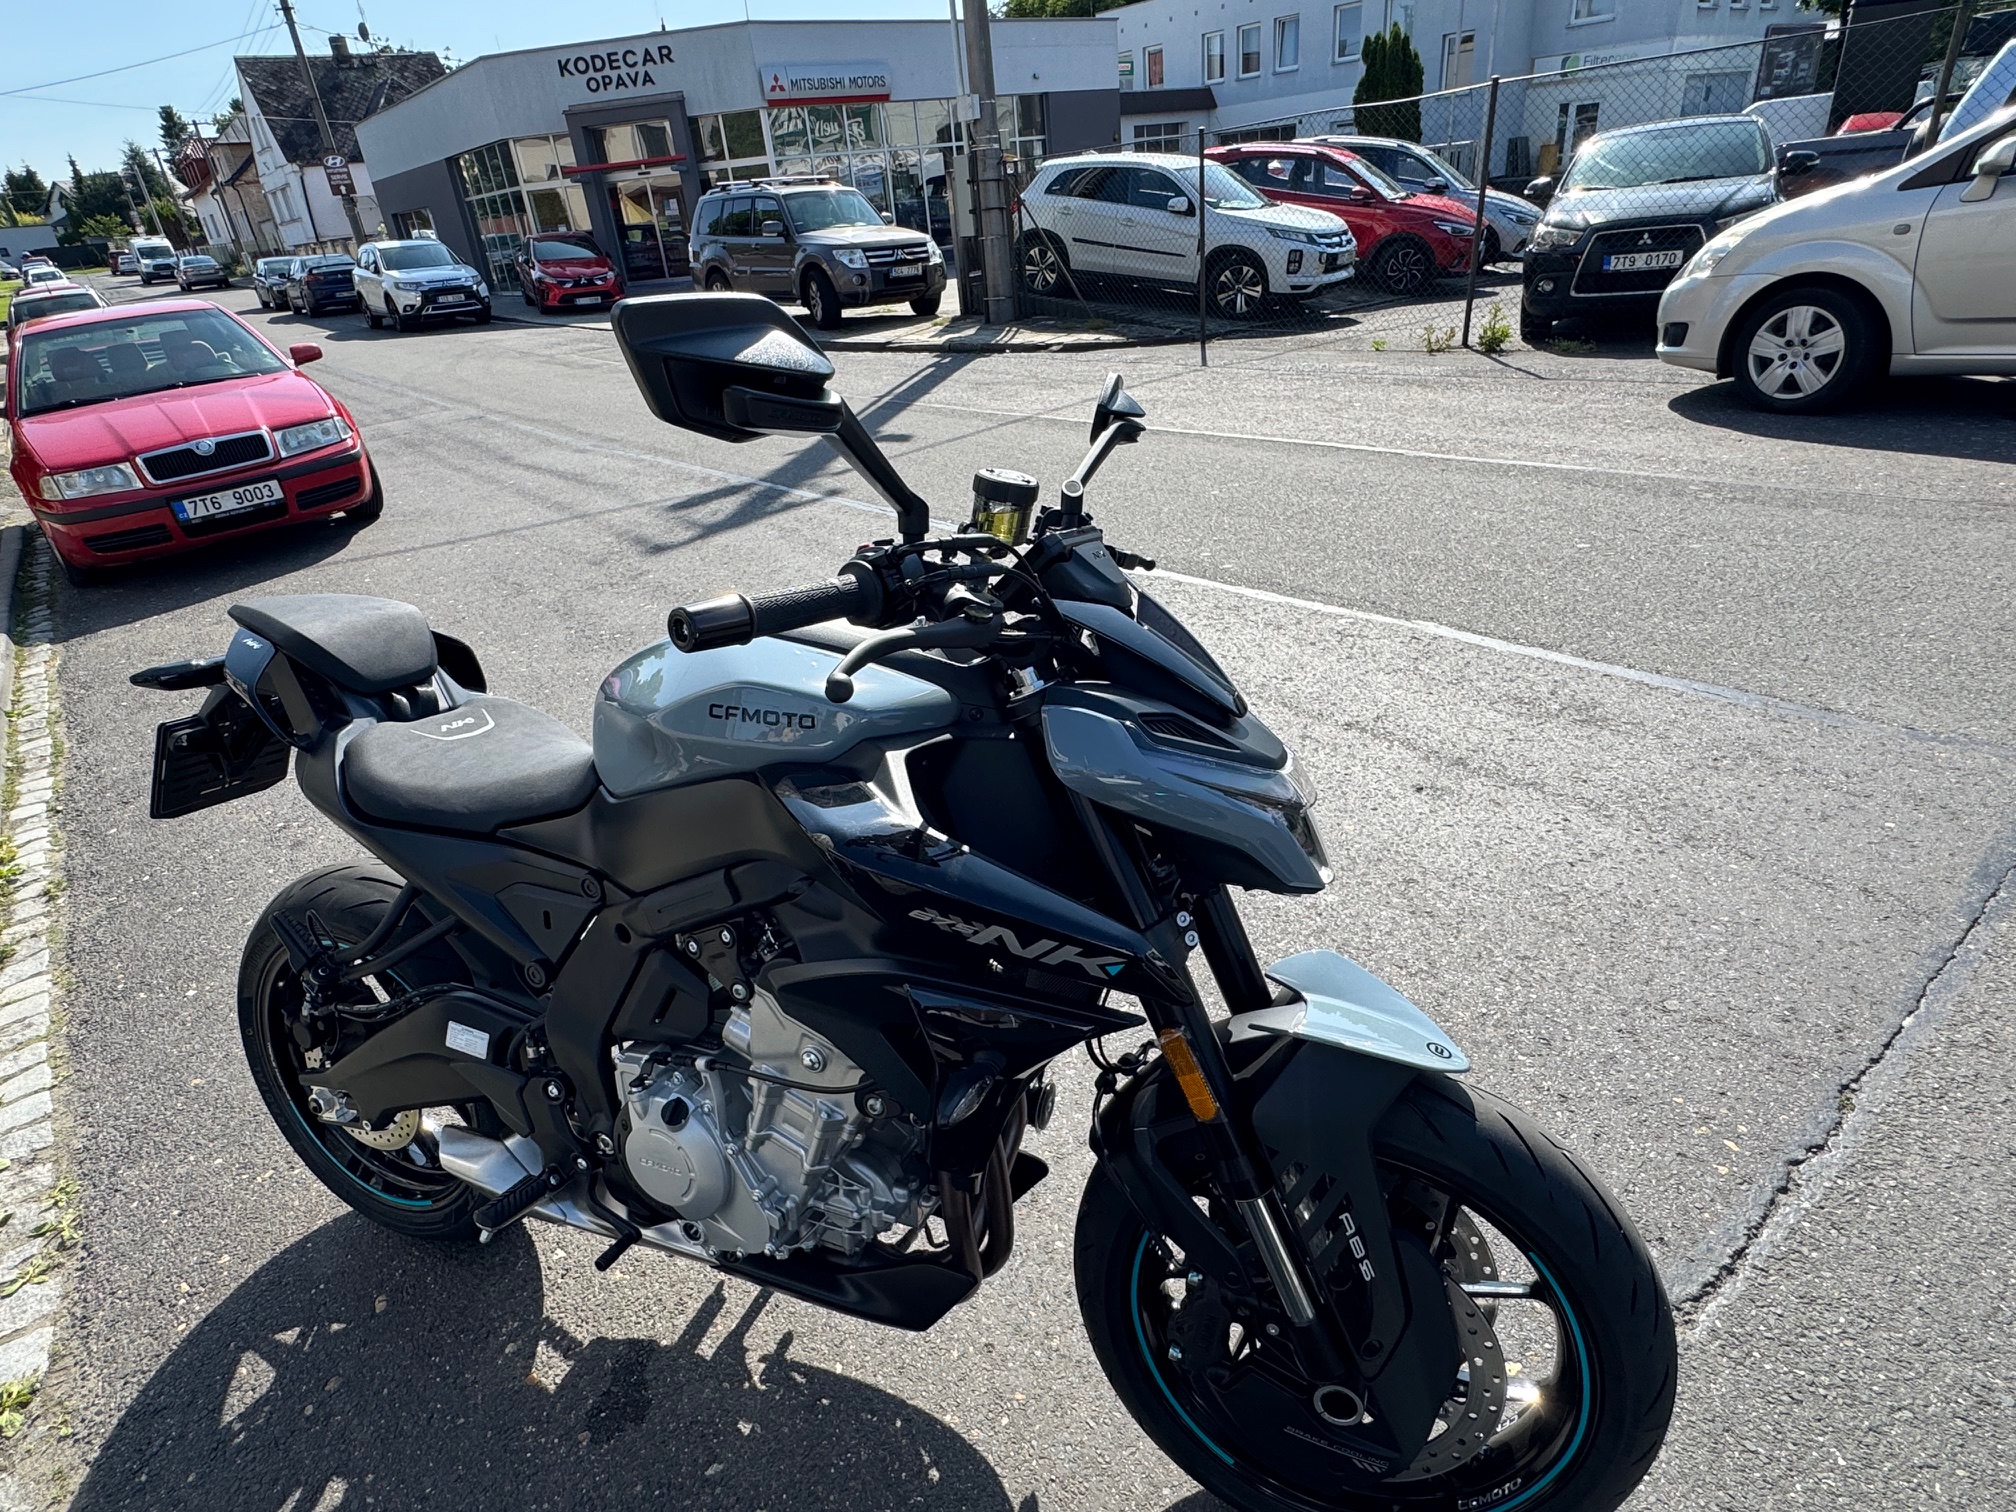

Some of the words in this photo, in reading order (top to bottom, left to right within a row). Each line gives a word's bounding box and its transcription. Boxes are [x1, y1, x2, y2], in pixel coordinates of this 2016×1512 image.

[557, 44, 676, 78] KODECAR
[586, 69, 656, 93] OPAVA
[790, 77, 846, 92] MITSUBISHI
[849, 74, 887, 90] MOTORS
[1613, 255, 1636, 269] 7T9
[1644, 252, 1677, 266] 0170
[187, 496, 223, 516] 7T6
[232, 484, 275, 506] 9003
[708, 703, 816, 730] CFMOTO
[1338, 1212, 1376, 1282] ABS
[1286, 1425, 1330, 1447] BRAKE
[1333, 1445, 1390, 1467] COOLING
[1457, 1477, 1522, 1511] CFMOTO
